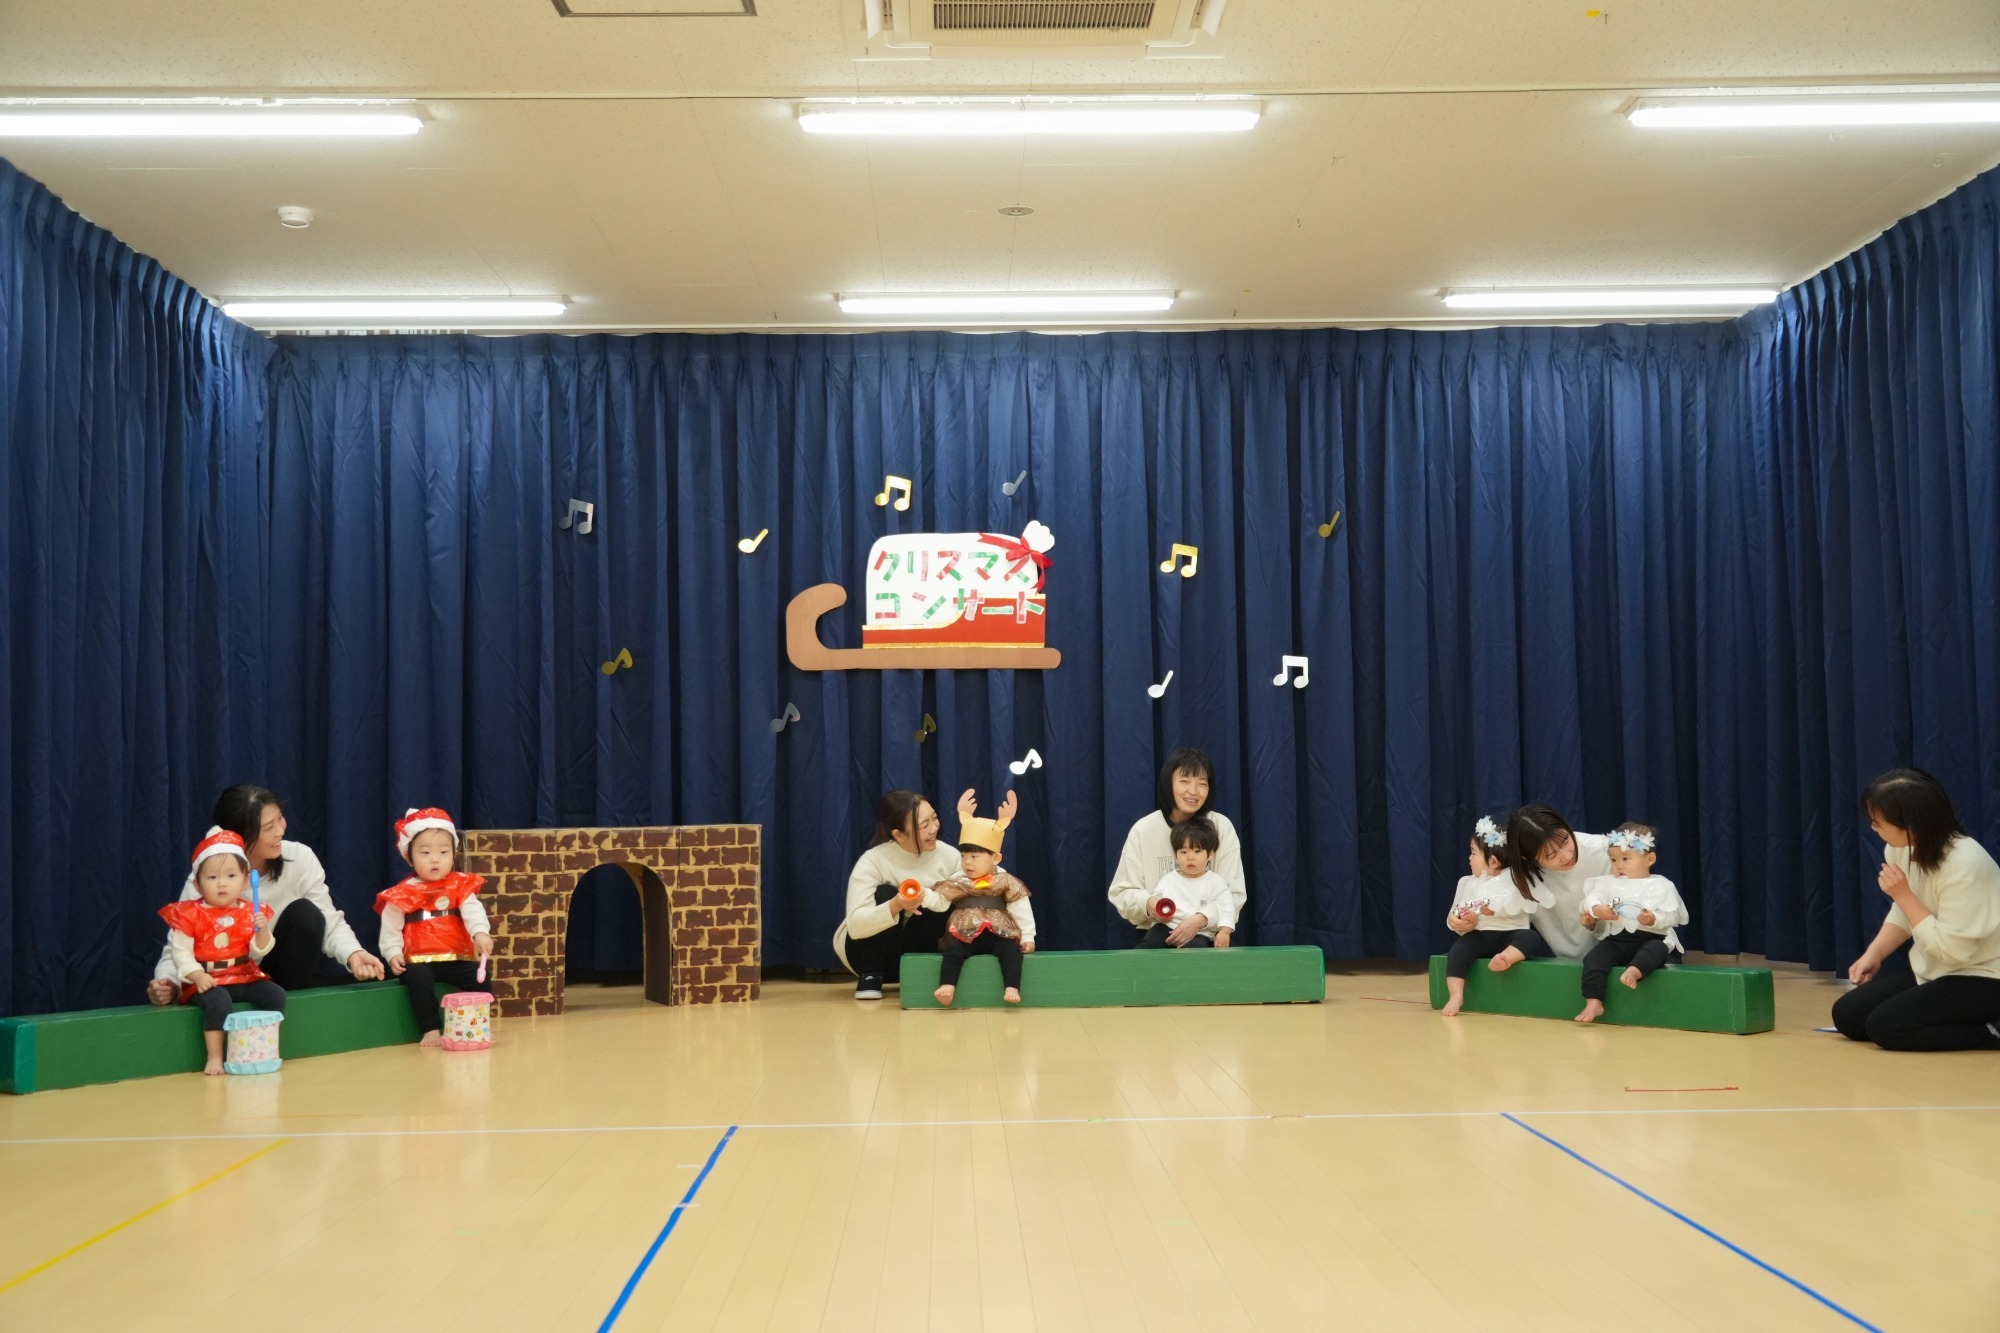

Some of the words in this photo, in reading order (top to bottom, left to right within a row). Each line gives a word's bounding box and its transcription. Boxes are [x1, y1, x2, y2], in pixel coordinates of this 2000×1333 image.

[875, 588, 1044, 624] コンサート
